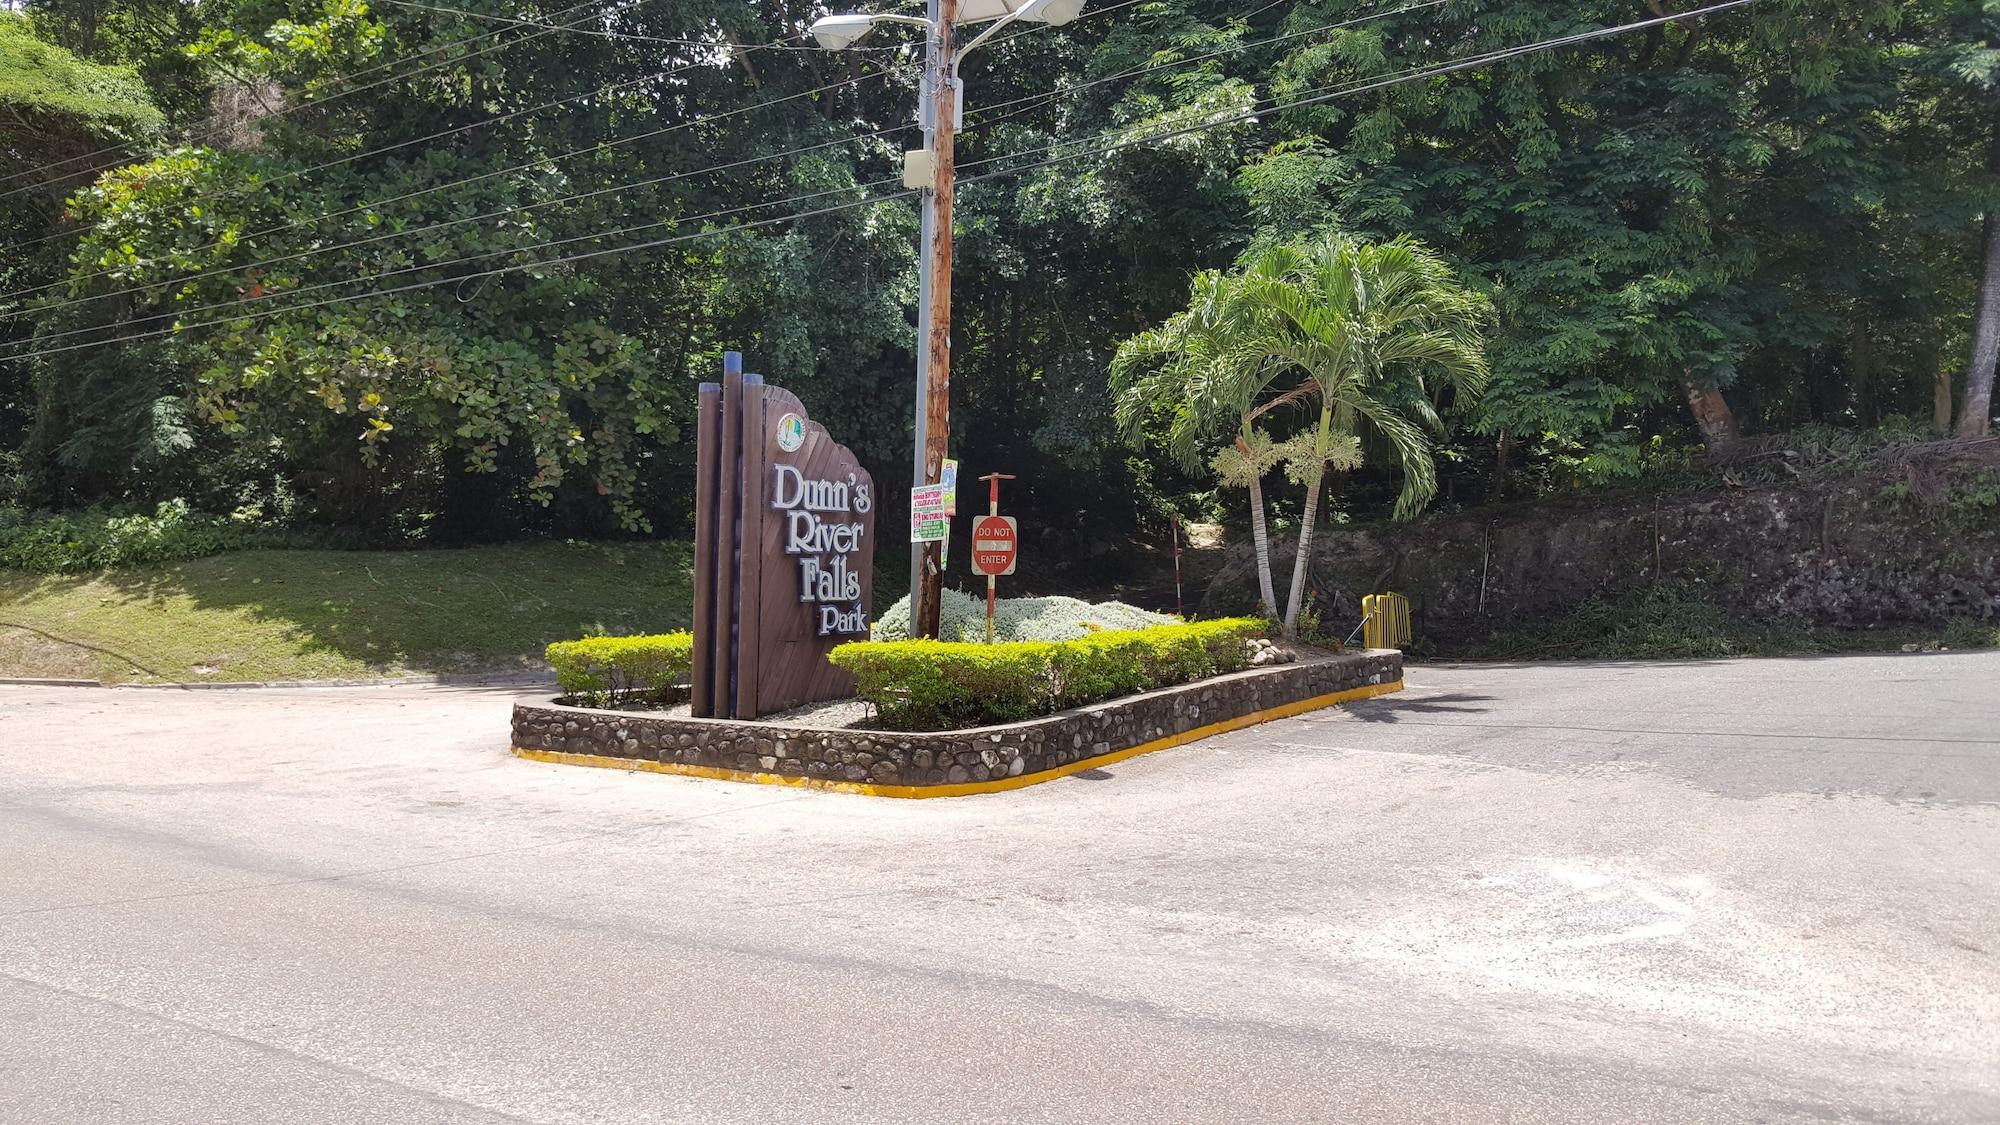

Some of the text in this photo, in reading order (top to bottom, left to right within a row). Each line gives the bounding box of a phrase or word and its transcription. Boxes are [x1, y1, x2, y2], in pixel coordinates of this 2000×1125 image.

[773, 463, 872, 514] Dunn's
[786, 510, 864, 554] River
[978, 527, 1011, 537] DO NOT
[800, 555, 861, 602] Falls
[980, 555, 1007, 564] ENTER
[819, 600, 868, 636] Park
